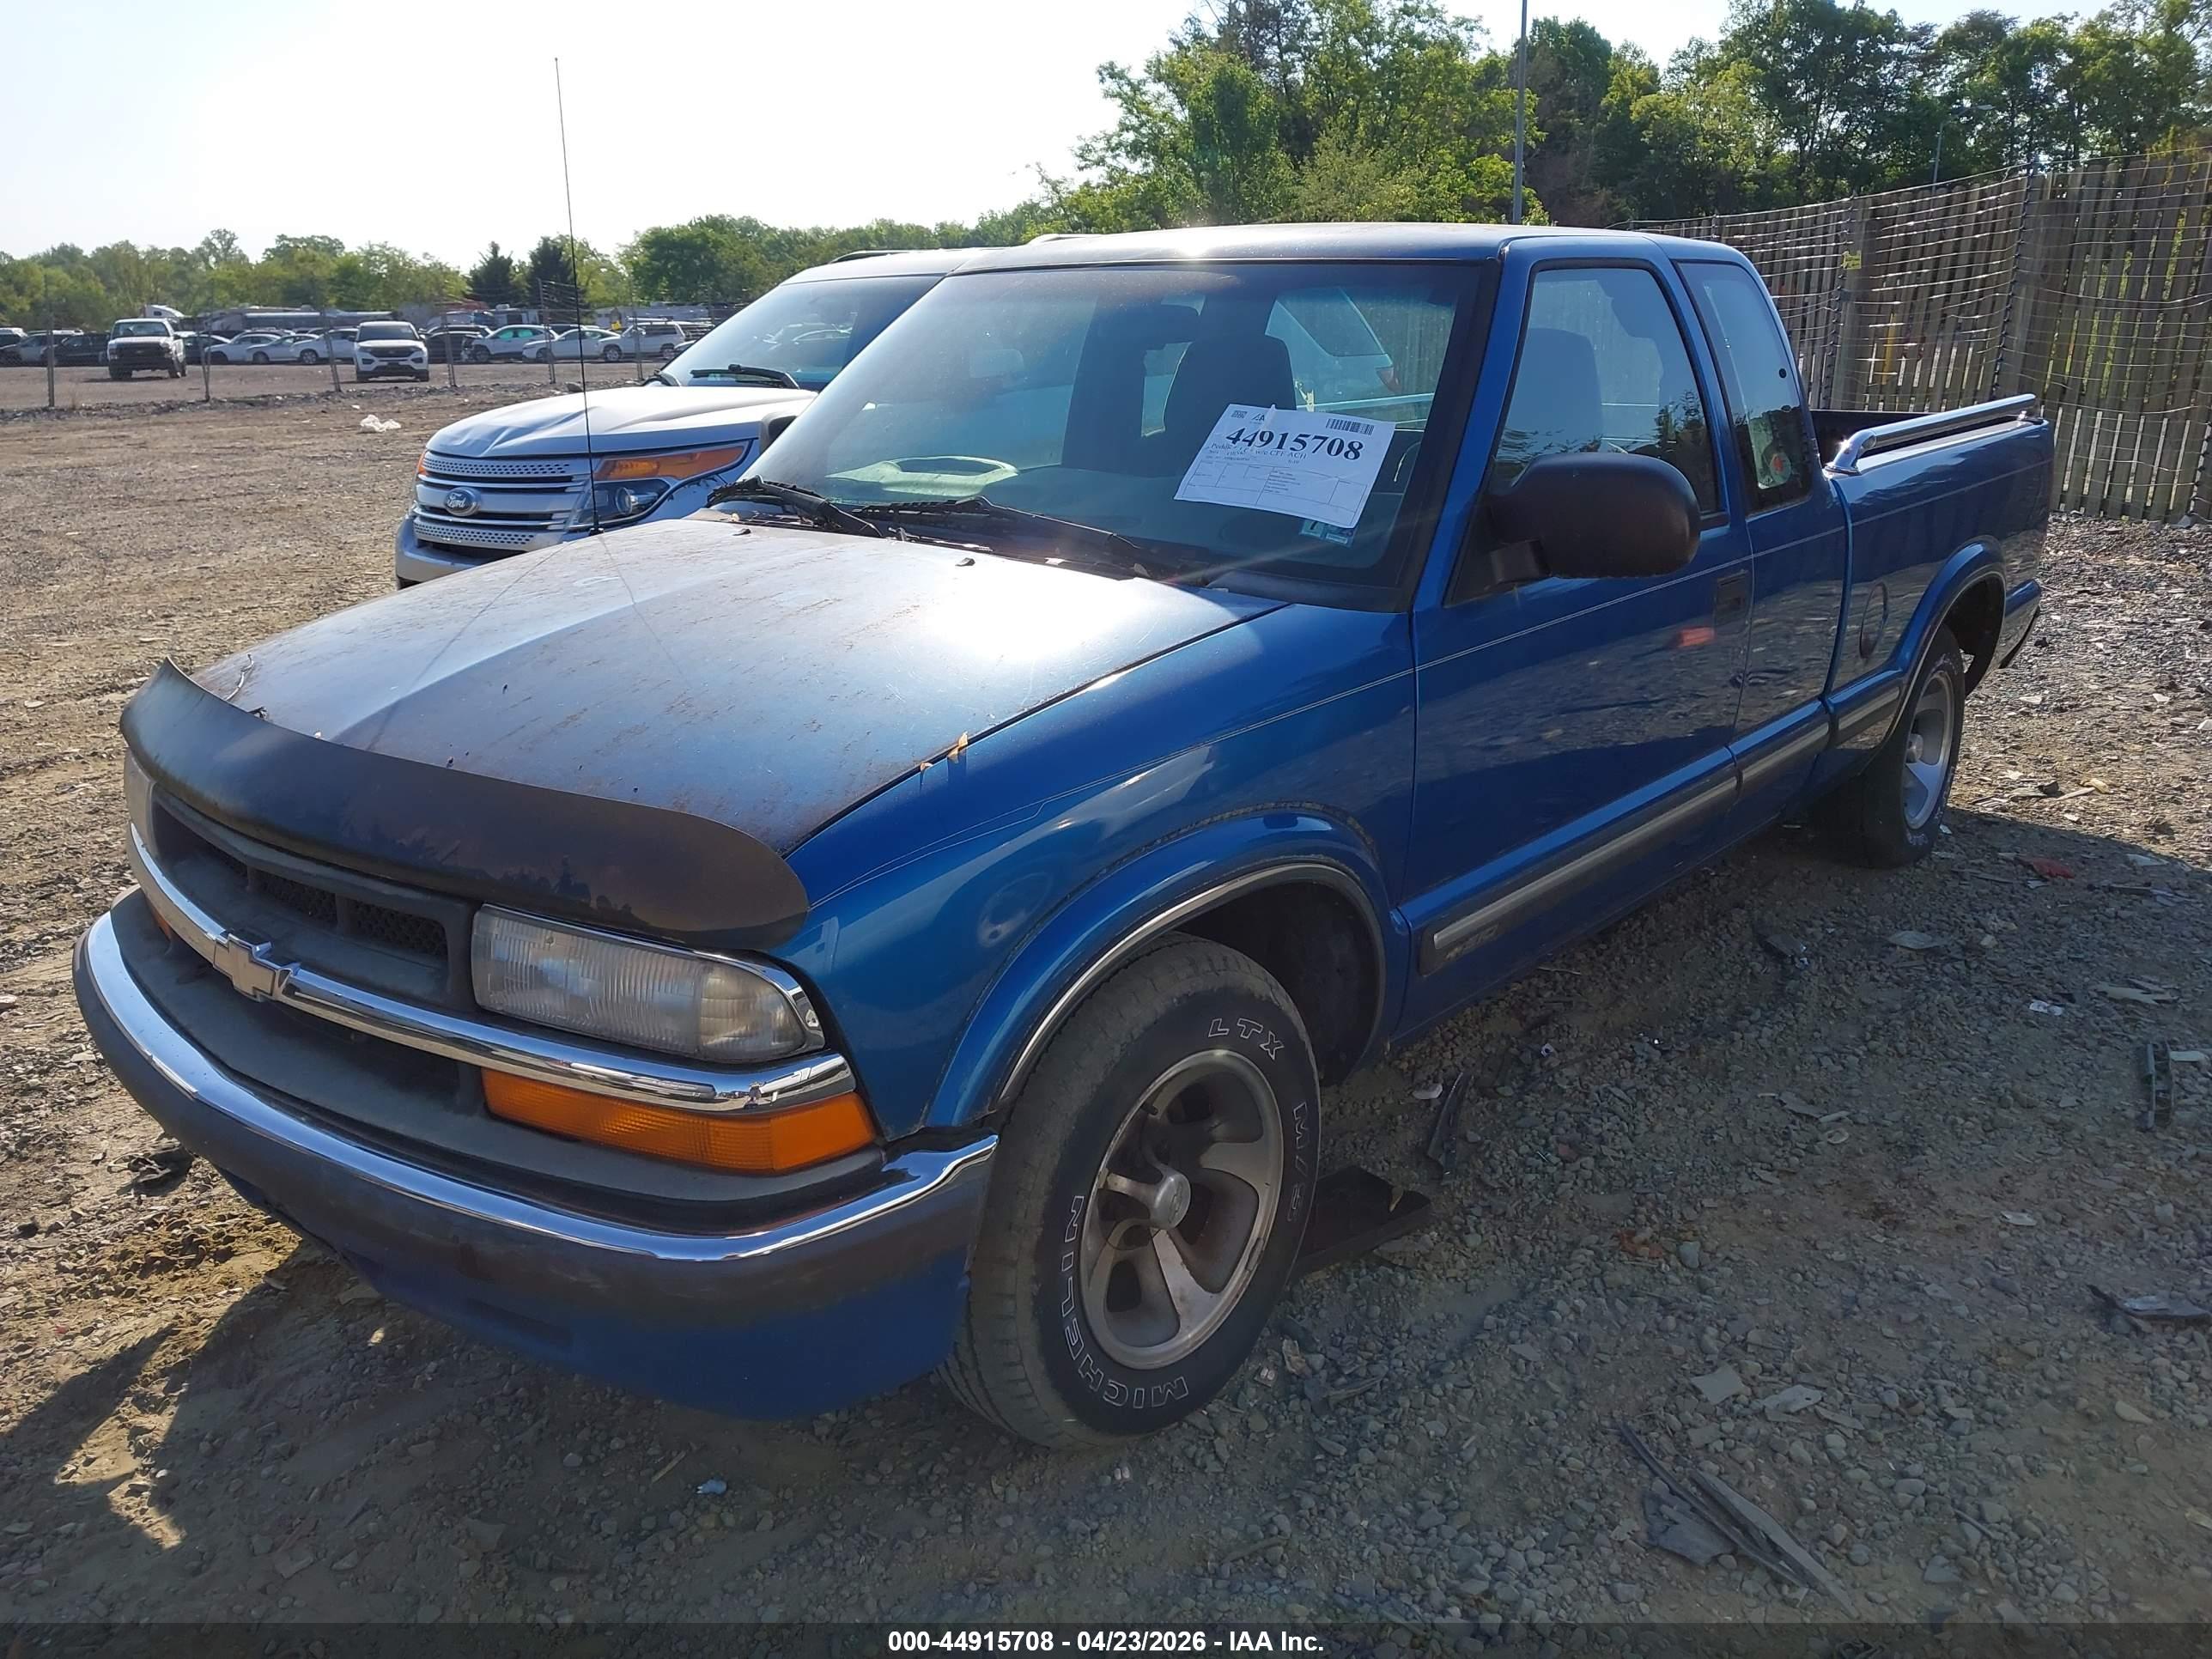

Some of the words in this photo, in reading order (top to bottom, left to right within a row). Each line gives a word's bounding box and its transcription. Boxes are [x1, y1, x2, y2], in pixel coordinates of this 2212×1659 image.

[1226, 428, 1364, 460] 44915708
[447, 492, 467, 508] Ford
[1207, 1017, 1285, 1061] LTX
[1060, 1195, 1189, 1409] MICHELIN
